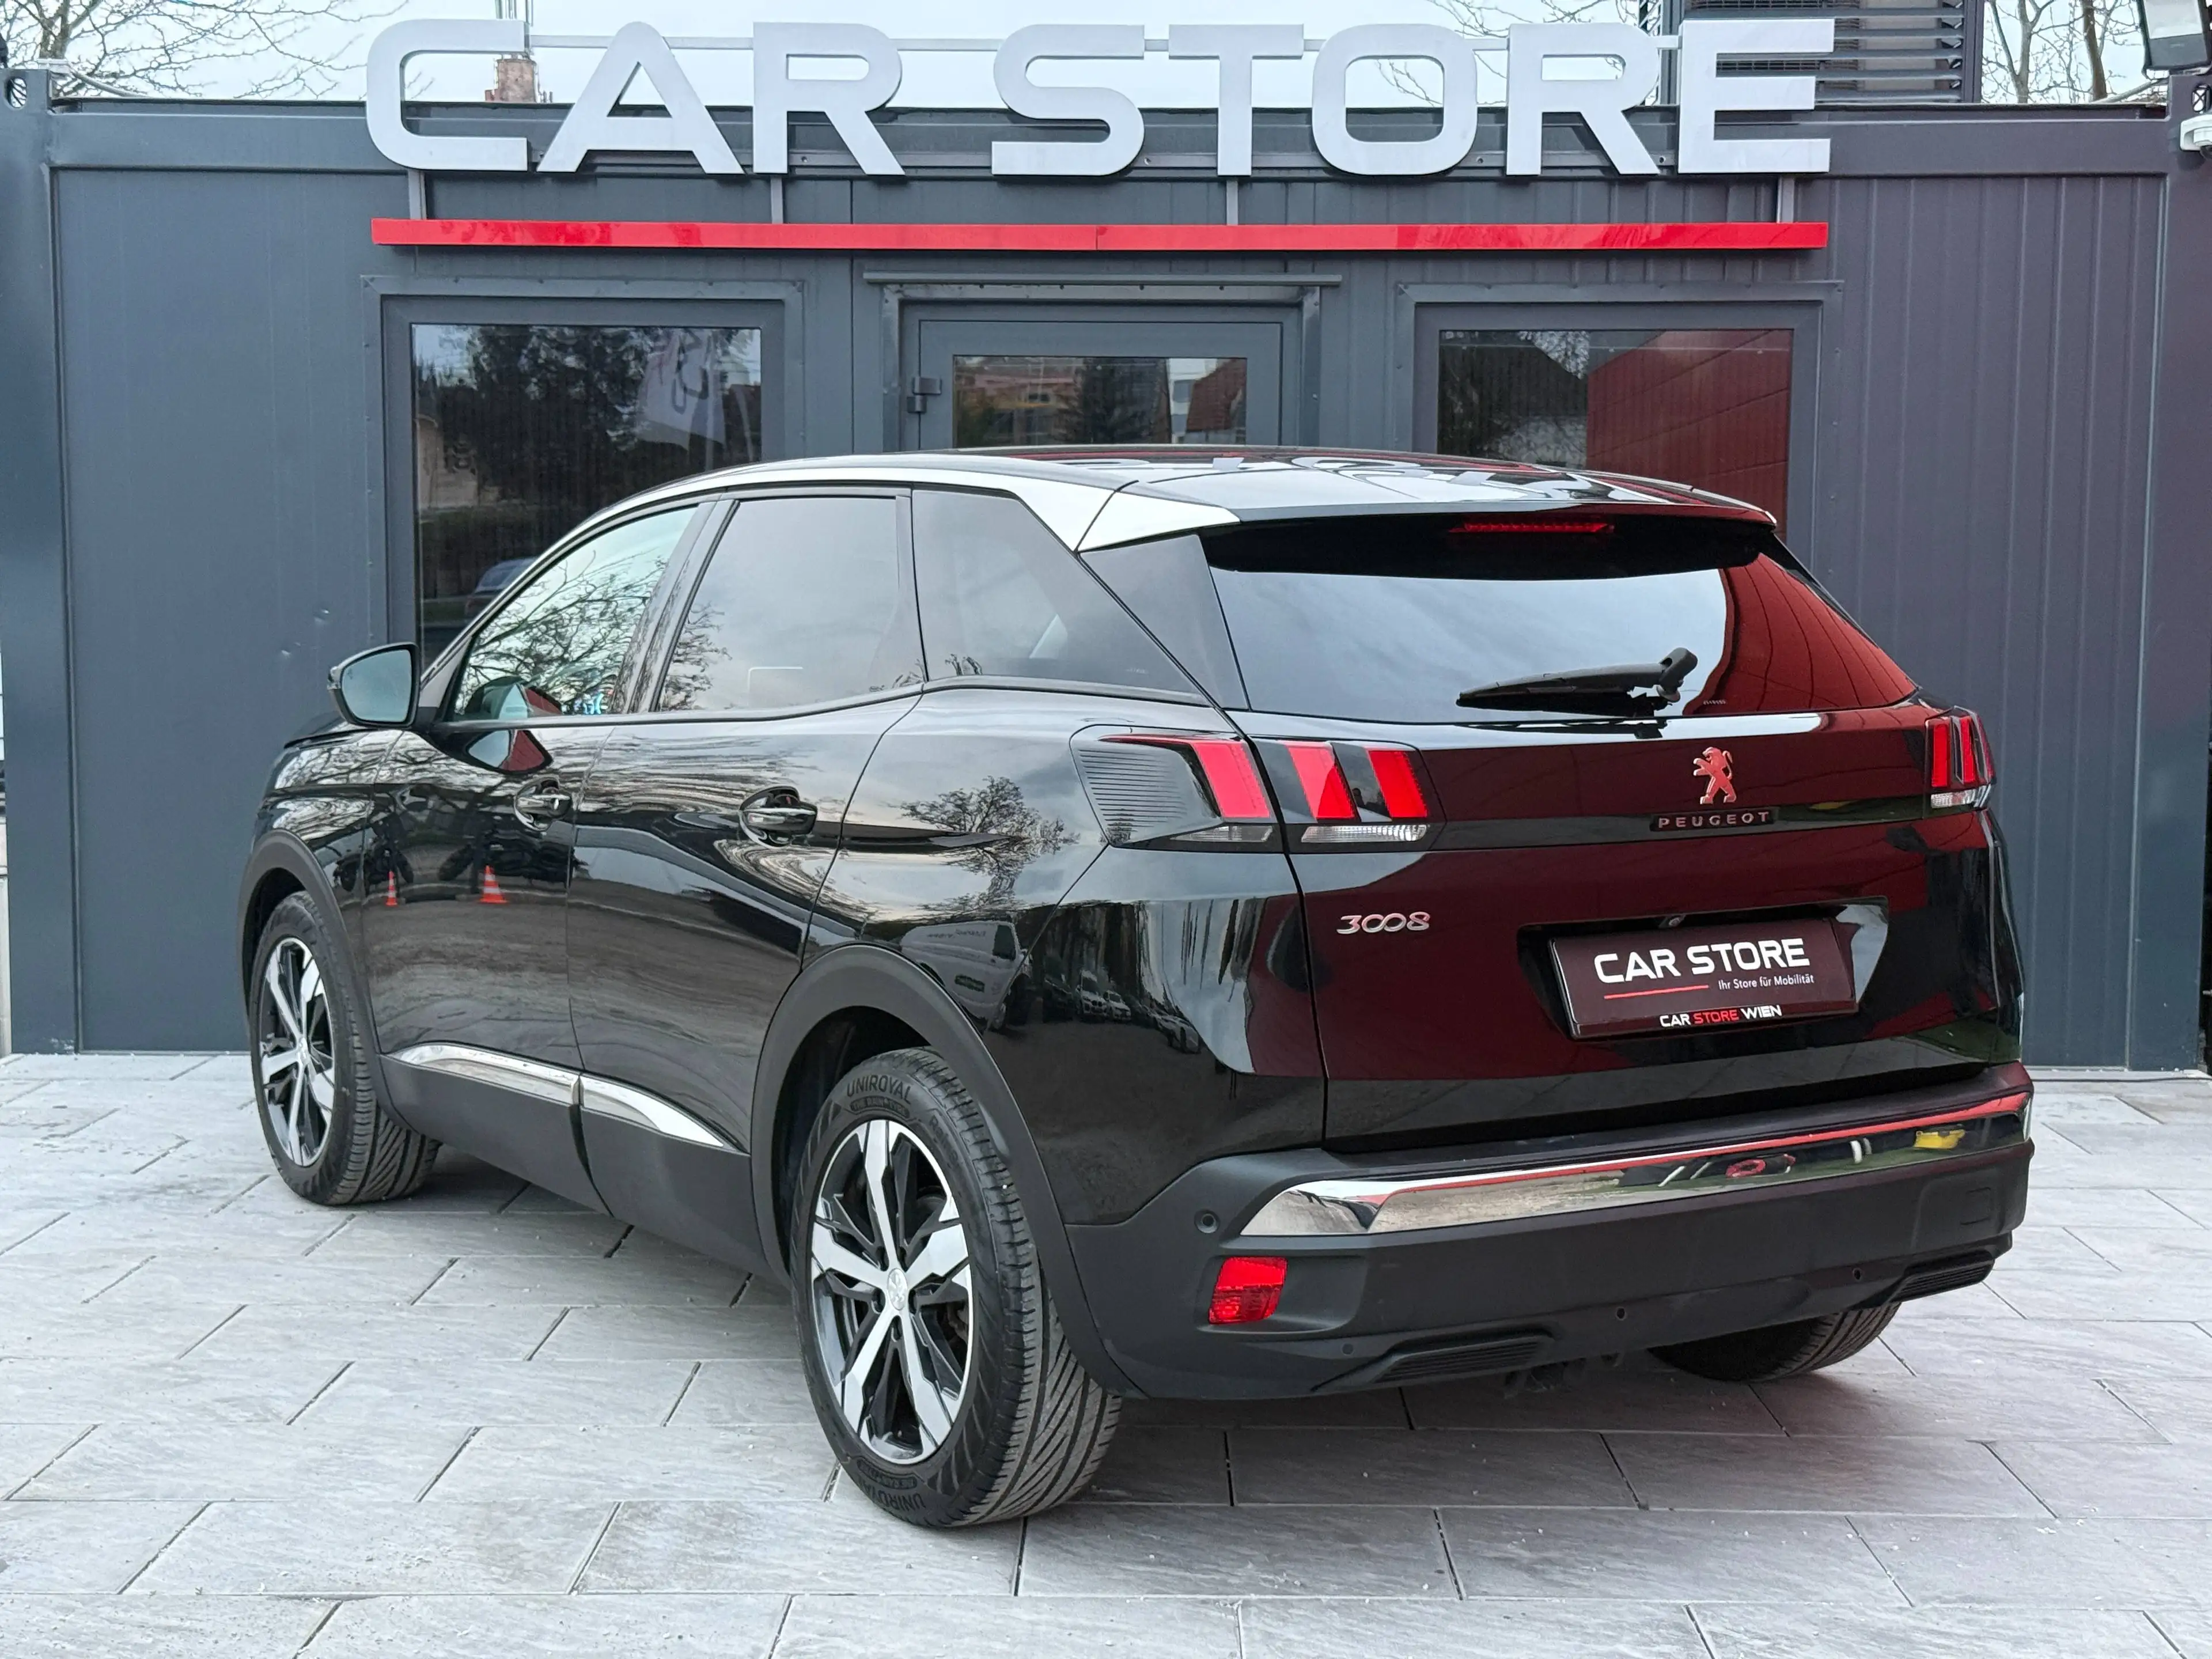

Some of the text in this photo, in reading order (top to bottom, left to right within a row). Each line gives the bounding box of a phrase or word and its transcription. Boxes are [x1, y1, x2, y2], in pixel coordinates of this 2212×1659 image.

[366, 18, 1835, 176] CAR STORE
[1658, 811, 1770, 828] PEUGEOT
[1336, 911, 1431, 935] 3008
[1593, 938, 1810, 984] CAR STORE
[1718, 973, 1815, 990] Ihr Store für Mobilität
[1659, 1005, 1783, 1027] CAR STORE WIEN
[846, 1074, 911, 1105] UNIROYAL
